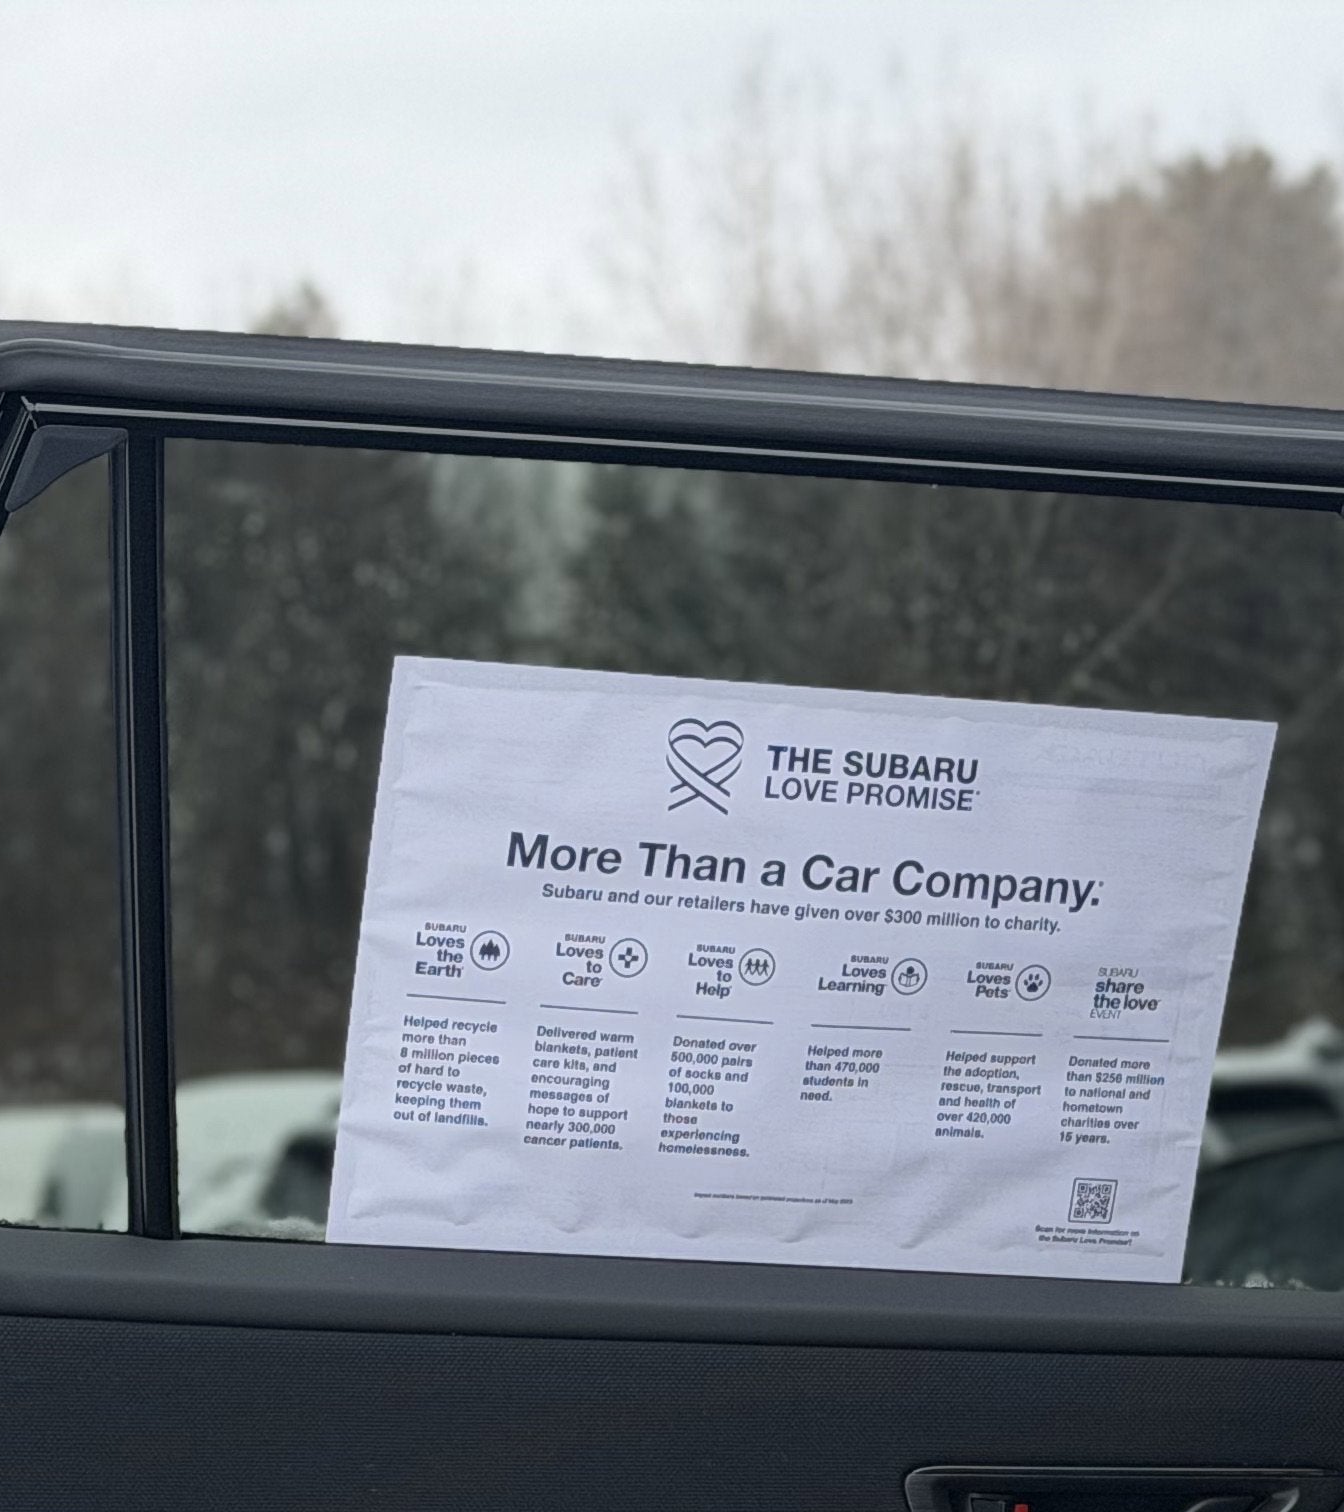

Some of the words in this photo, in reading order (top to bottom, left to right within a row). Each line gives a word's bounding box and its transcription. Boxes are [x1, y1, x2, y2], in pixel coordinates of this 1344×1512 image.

[767, 744, 833, 775] THE
[842, 750, 979, 785] SUBARU
[764, 775, 839, 803] LOVE
[846, 781, 975, 812] PROMISE
[506, 831, 622, 875] More
[638, 841, 746, 884] Than
[760, 860, 786, 887] a
[802, 854, 881, 893] Car
[892, 859, 1100, 913] Company.
[542, 883, 603, 901] Subaru
[607, 889, 640, 904] and
[644, 894, 674, 906] our
[677, 895, 745, 913] retailers
[750, 898, 790, 917] have
[794, 903, 840, 921] given
[844, 909, 881, 922] over
[884, 908, 922, 925] $300
[926, 912, 980, 928] million
[984, 914, 1000, 929] to
[1004, 915, 1061, 935] charity.
[424, 922, 467, 933] SUBARU
[416, 931, 465, 949] Loves
[564, 933, 606, 944] SUBARU
[436, 948, 464, 964] the
[556, 942, 604, 960] Loves
[696, 944, 736, 955] SUBARU
[586, 960, 603, 974] to
[688, 952, 734, 969] Loves
[850, 954, 889, 965] SUBARU
[975, 961, 1014, 971] SUBARU
[415, 961, 464, 978] Earth
[716, 969, 733, 983] to
[841, 963, 887, 979] Loves
[1098, 967, 1139, 978] SUBARU
[562, 971, 603, 988] Care
[818, 976, 888, 996] Learning
[967, 971, 1011, 986] Loves
[1095, 979, 1144, 994] share
[695, 981, 732, 1000] Help
[975, 984, 1008, 999] Pets
[1093, 994, 1120, 1009] the
[1123, 995, 1158, 1011] love
[1089, 1009, 1122, 1019] EVENT
[403, 1015, 449, 1031] Helped
[451, 1021, 498, 1035] recycle
[402, 1033, 435, 1044] more
[438, 1034, 467, 1047] than
[536, 1025, 597, 1041] Delivered
[600, 1032, 634, 1044] warm
[534, 1040, 591, 1058] blankets,
[593, 1046, 638, 1059] patient
[673, 1035, 726, 1051] Donated
[728, 1042, 757, 1053] over
[807, 1045, 850, 1059] Helped
[852, 1049, 883, 1059] more
[400, 1047, 408, 1058] 8
[411, 1048, 455, 1061] million
[457, 1051, 500, 1065] pieces
[670, 1051, 719, 1065] 500,000
[720, 1055, 753, 1068] pairs
[945, 1050, 988, 1065] Helped
[990, 1054, 1036, 1067] support
[1068, 1055, 1118, 1069] Donated
[1120, 1060, 1151, 1070] more
[398, 1062, 412, 1074] of
[414, 1063, 444, 1076] hard
[447, 1065, 461, 1078] to
[532, 1058, 560, 1069] care
[563, 1058, 589, 1073] kits,
[592, 1061, 617, 1073] and
[805, 1060, 832, 1072] than
[834, 1061, 880, 1075] 470,000
[943, 1065, 962, 1077] the
[964, 1067, 1020, 1081] adoption,
[531, 1074, 610, 1091] encouraging
[668, 1066, 683, 1078] of
[684, 1068, 722, 1081] socks
[724, 1072, 749, 1083] and
[802, 1075, 854, 1087] students
[857, 1076, 869, 1088] in
[1066, 1071, 1092, 1082] than
[1125, 1073, 1165, 1086] million
[396, 1079, 443, 1093] recycle
[446, 1083, 487, 1097] waste,
[668, 1081, 715, 1096] 100,000
[800, 1090, 832, 1101] need.
[940, 1082, 984, 1095] rescue,
[987, 1082, 1041, 1097] transport
[1064, 1086, 1077, 1097] to
[1079, 1087, 1126, 1099] national
[1128, 1089, 1151, 1100] and
[395, 1092, 446, 1110] keeping
[449, 1097, 482, 1110] them
[529, 1089, 593, 1104] messages
[596, 1092, 610, 1104] of
[665, 1096, 718, 1111] blankets
[721, 1100, 734, 1112] to
[938, 1096, 962, 1107] and
[964, 1096, 1001, 1109] health
[1003, 1098, 1017, 1109] of
[528, 1102, 560, 1118] hope
[562, 1105, 576, 1117] to
[578, 1108, 628, 1122] support
[1062, 1101, 1123, 1114] hometown
[393, 1110, 415, 1121] out
[418, 1110, 431, 1122] of
[434, 1111, 488, 1127] landfills.
[663, 1112, 698, 1125] those
[936, 1112, 964, 1122] over
[966, 1111, 1011, 1125] 420,000
[1060, 1116, 1111, 1129] charities
[1114, 1120, 1140, 1130] over
[526, 1120, 565, 1134] nearly
[567, 1121, 616, 1135] 300,000
[935, 1126, 984, 1139] animals.
[523, 1135, 567, 1146] cancer
[569, 1137, 623, 1151] patients.
[660, 1128, 740, 1145] experiencing
[1060, 1131, 1073, 1142] 15
[1075, 1133, 1110, 1145] years.
[658, 1141, 750, 1157] homelessness.
